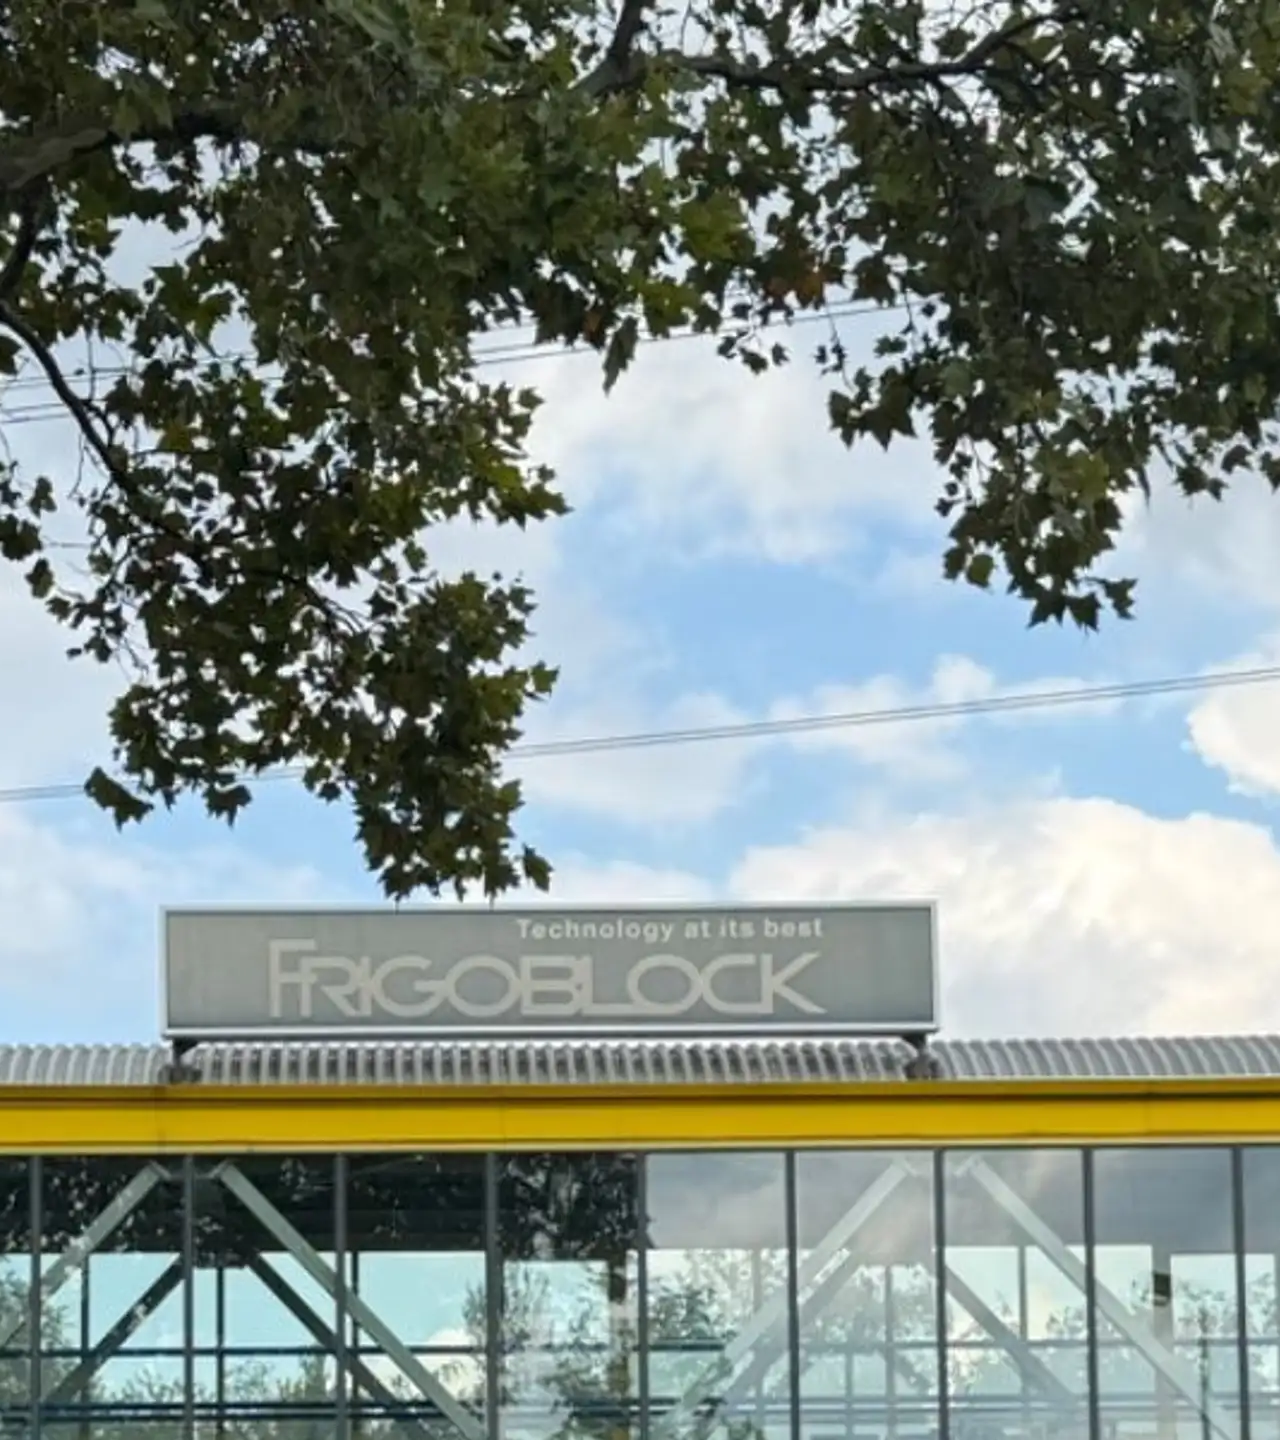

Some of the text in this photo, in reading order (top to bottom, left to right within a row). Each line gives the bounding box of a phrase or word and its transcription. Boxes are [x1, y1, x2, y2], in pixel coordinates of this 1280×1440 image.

[518, 917, 824, 942] Technology at its best
[269, 939, 828, 1018] FRIGOBLOCK
